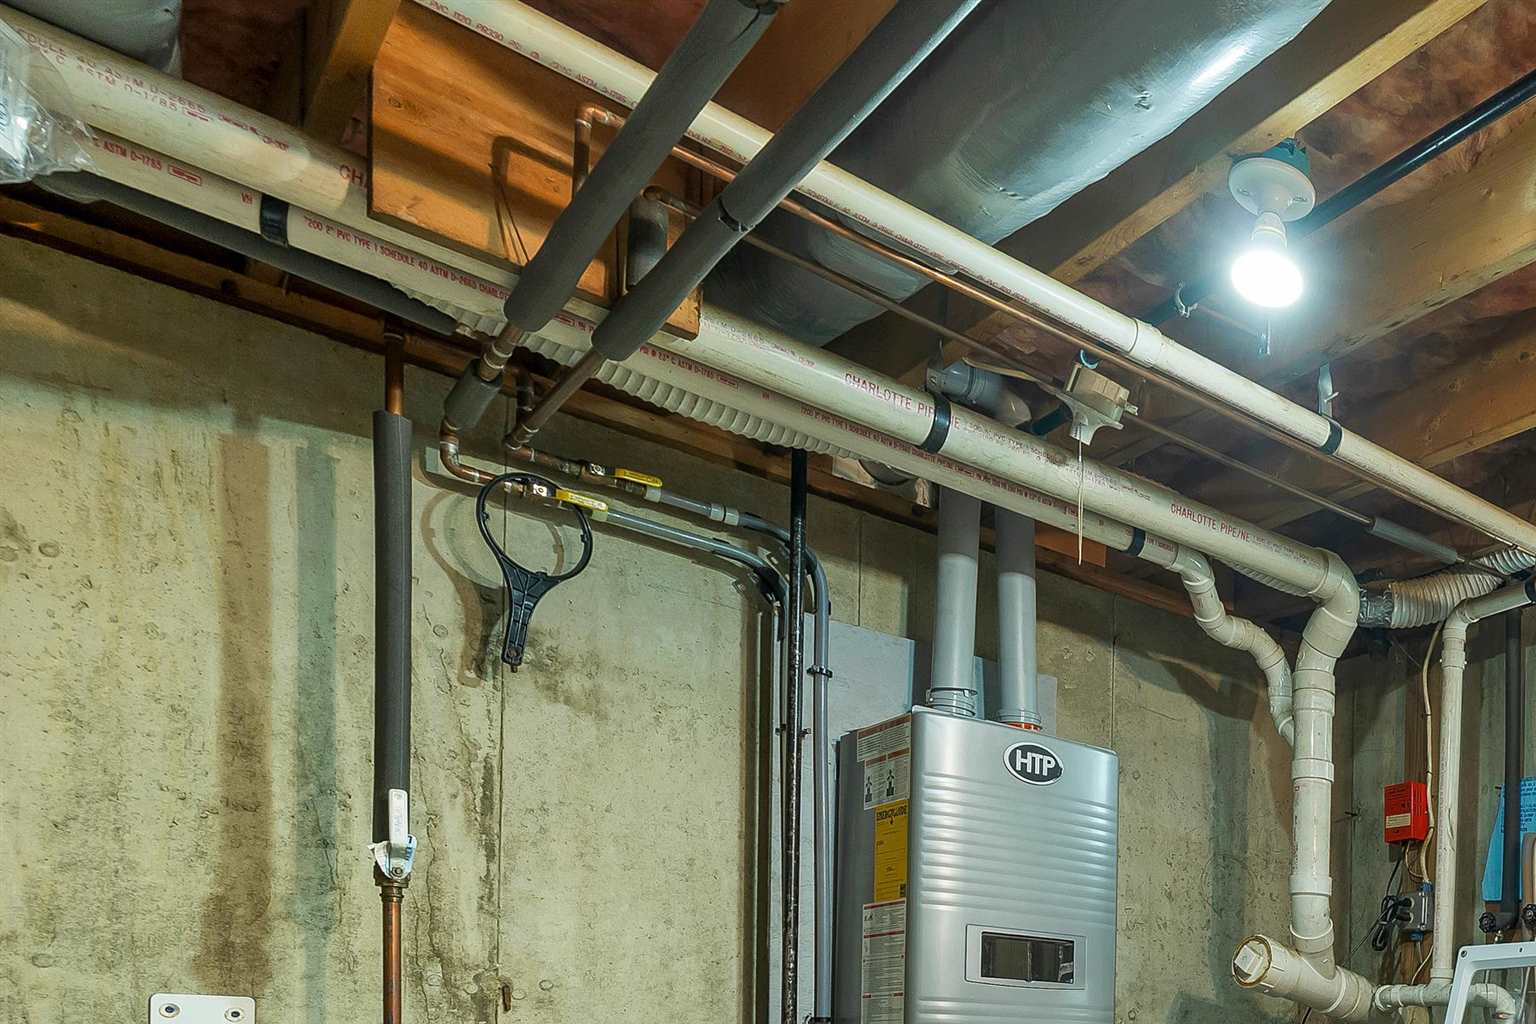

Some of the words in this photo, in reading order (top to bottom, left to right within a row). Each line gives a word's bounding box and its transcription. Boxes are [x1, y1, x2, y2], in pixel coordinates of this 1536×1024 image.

[380, 245, 415, 268] SCHEDULE
[844, 372, 913, 411] CHARLOTTE
[1170, 503, 1217, 531] CHARLOTTE
[1016, 749, 1056, 776] HTP
